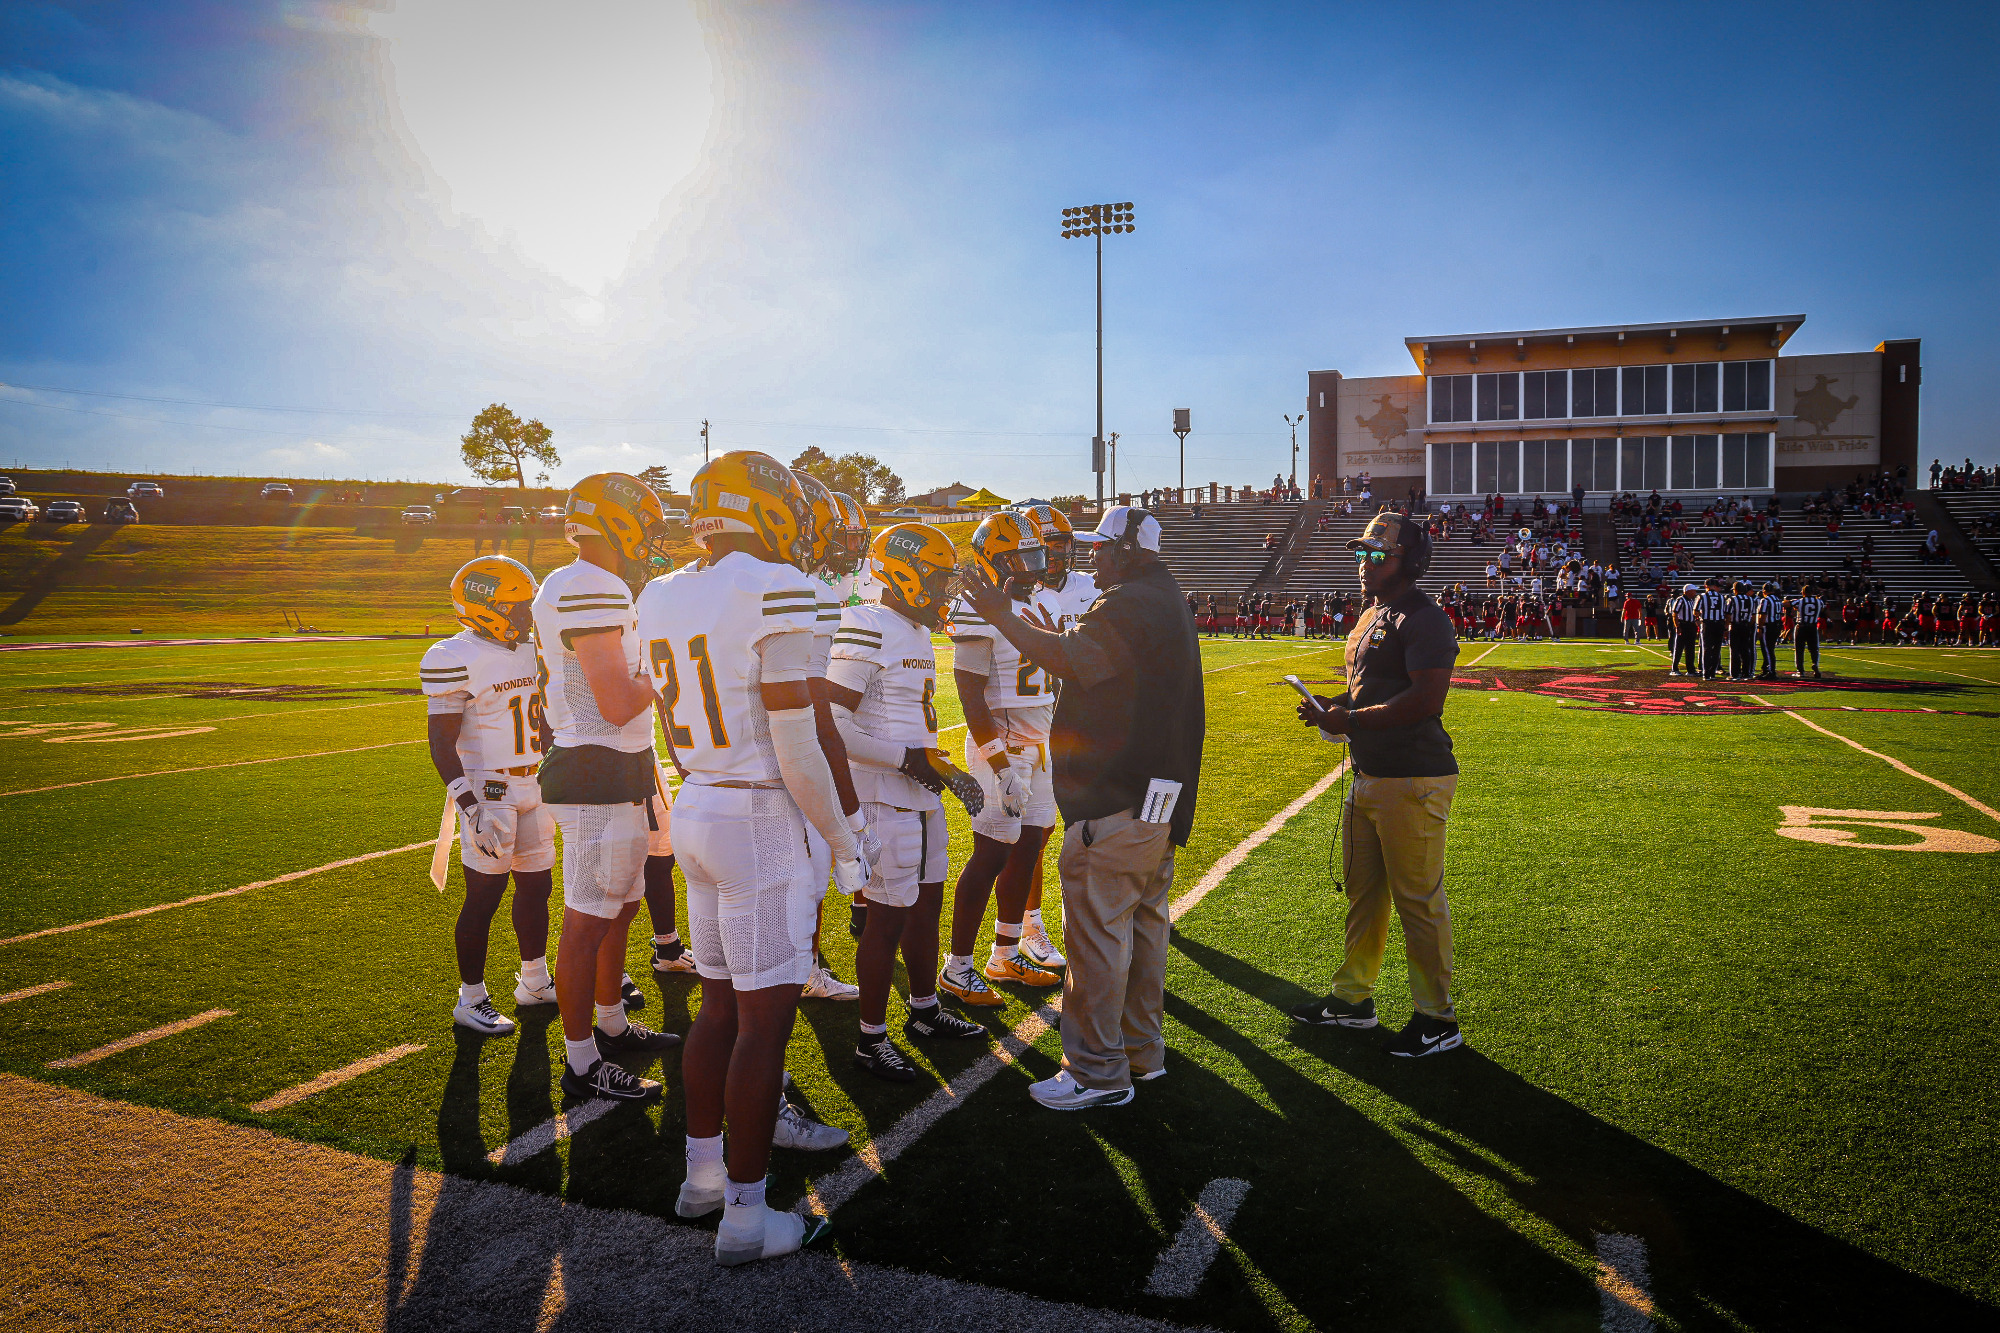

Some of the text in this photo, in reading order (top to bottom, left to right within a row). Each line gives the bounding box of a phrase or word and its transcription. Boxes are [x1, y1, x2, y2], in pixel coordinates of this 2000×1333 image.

[1777, 439, 1869, 452] Ride With Pride
[1345, 453, 1422, 465] Ride With Pride
[747, 462, 790, 488] TECH
[605, 480, 642, 502] TECH
[889, 534, 921, 553] TECH
[464, 579, 496, 597] TECH
[1710, 596, 1719, 609] F
[1804, 603, 1816, 616] C
[492, 676, 534, 693] WONDER
[650, 634, 731, 749] 21
[507, 692, 542, 756] 19
[485, 786, 505, 795] TECH
[912, 1020, 935, 1036] NIKE
